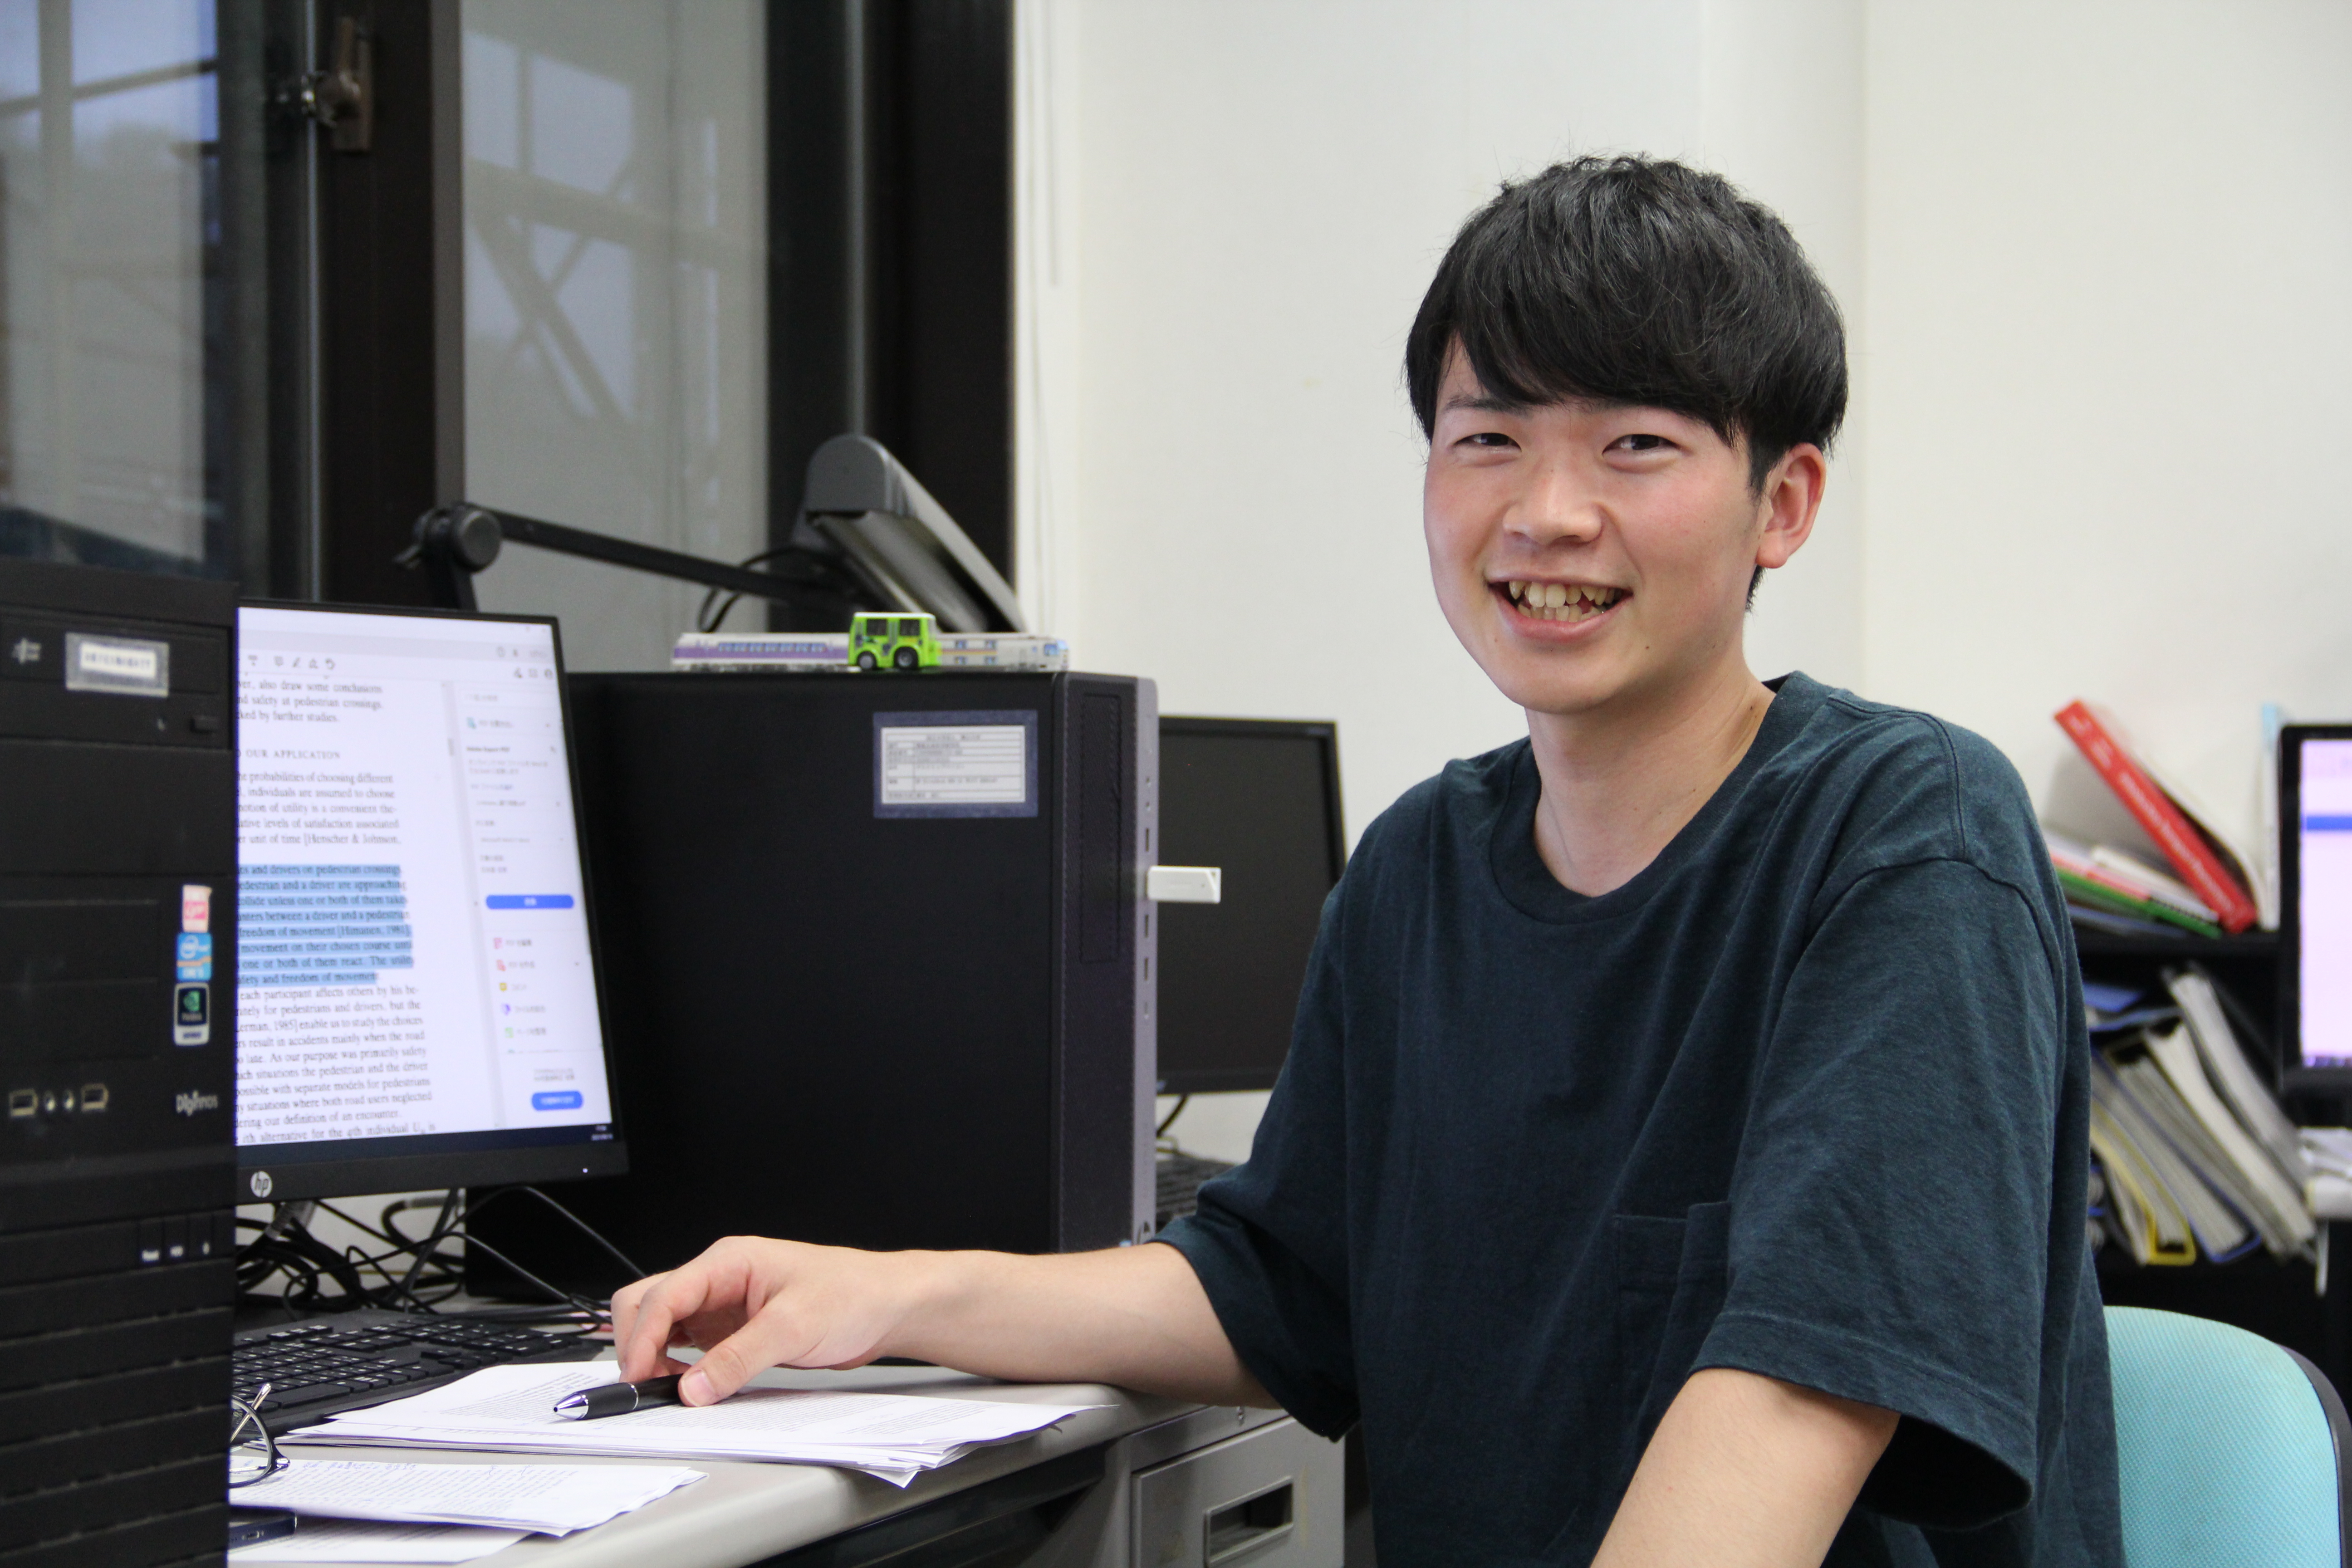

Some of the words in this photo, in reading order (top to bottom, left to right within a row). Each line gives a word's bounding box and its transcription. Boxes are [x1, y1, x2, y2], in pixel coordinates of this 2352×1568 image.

[259, 680, 277, 690] also
[280, 680, 302, 691] draw
[307, 684, 329, 692] some
[333, 682, 382, 694] conclusions
[252, 695, 277, 708] safety
[294, 696, 339, 710] pedestrian
[343, 697, 383, 711] crossings.
[273, 710, 303, 721] further
[307, 711, 339, 722] studies.
[245, 750, 268, 759] OUR
[274, 750, 340, 759] APPLICATION
[250, 771, 303, 784] probabilities
[317, 773, 354, 785] choosing
[357, 773, 394, 784] different
[247, 787, 296, 798] individuals
[315, 788, 352, 798] assumed
[366, 788, 394, 798] choose
[240, 803, 266, 813] notion
[282, 803, 308, 815] utility
[330, 803, 377, 813] convenient
[379, 803, 397, 813] the-
[263, 818, 289, 828] levels
[304, 818, 353, 828] satisfaction
[356, 818, 399, 828] associated
[249, 833, 266, 843] unit
[281, 833, 300, 843] time
[363, 833, 401, 844] Johnson,
[252, 864, 267, 874] and
[270, 864, 300, 874] drivers
[316, 864, 362, 877] pedestrian
[283, 880, 299, 890] and
[310, 879, 334, 890] driver
[355, 879, 406, 892] approaching
[268, 895, 294, 905] unless
[328, 894, 348, 904] both
[362, 894, 384, 904] them
[265, 910, 302, 920] between
[312, 910, 338, 920] driver
[341, 910, 356, 920] and
[366, 909, 410, 922] pedestrian
[239, 926, 275, 936] freedom
[290, 925, 335, 936] movement
[241, 941, 288, 952] movement
[306, 941, 326, 951] their
[330, 941, 359, 951] chosen
[363, 942, 390, 951] course
[276, 957, 298, 967] both
[314, 956, 337, 967] them
[369, 956, 386, 966] The
[263, 973, 279, 983] and
[282, 972, 319, 982] freedom
[240, 989, 260, 999] each
[264, 987, 311, 1001] participant
[315, 987, 343, 997] affects
[347, 986, 373, 997] others
[390, 985, 403, 995] his
[405, 985, 418, 995] be-
[264, 1004, 277, 1014] for
[281, 1002, 331, 1016] pedestrians
[334, 1002, 350, 1012] and
[353, 1001, 386, 1013] drivers,
[389, 1000, 404, 1011] but
[407, 1000, 421, 1010] the
[299, 1019, 328, 1029] enable
[352, 1017, 374, 1030] study
[376, 1016, 389, 1027] the
[392, 1015, 423, 1026] choices
[249, 1036, 274, 1047] result
[289, 1034, 328, 1046] accidents
[331, 1033, 360, 1046] mainly
[363, 1032, 386, 1043] when
[388, 1031, 402, 1042] the
[405, 1030, 424, 1041] road
[284, 1053, 300, 1061] our
[303, 1052, 338, 1063] purpose
[341, 1051, 357, 1059] was
[360, 1047, 398, 1061] primarily
[402, 1046, 426, 1059] safety
[256, 1066, 299, 1078] situations
[302, 1066, 316, 1076] the
[319, 1063, 364, 1078] pedestrian
[368, 1063, 383, 1073] and
[386, 1062, 399, 1073] the
[402, 1061, 428, 1072] driver
[272, 1083, 291, 1093] with
[294, 1081, 331, 1095] separate
[333, 1079, 365, 1091] models
[367, 1079, 379, 1089] for
[382, 1077, 431, 1091] pedestrians
[247, 1098, 289, 1110] situations
[293, 1097, 319, 1108] where
[322, 1096, 342, 1107] both
[344, 1095, 365, 1106] road
[368, 1097, 389, 1105] users
[392, 1092, 432, 1106] neglected
[265, 1117, 279, 1125] our
[284, 1112, 327, 1124] definition
[252, 1171, 271, 1198] hp
